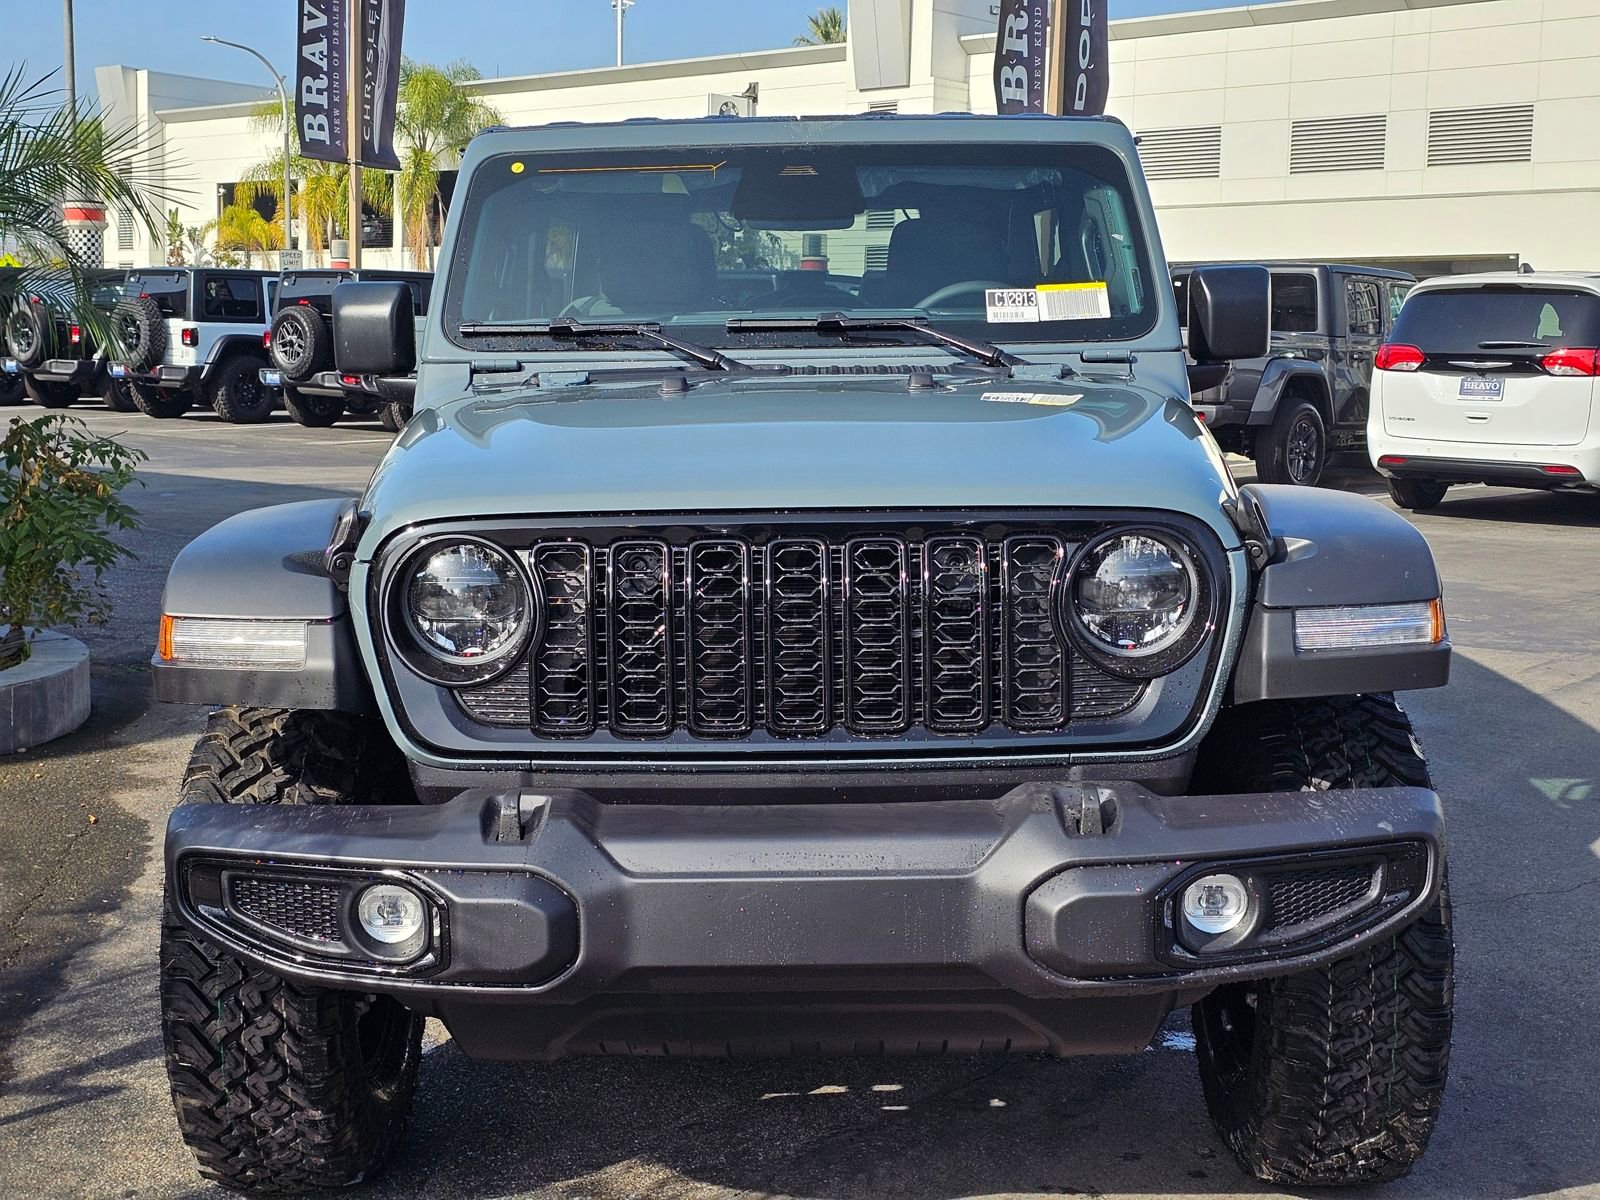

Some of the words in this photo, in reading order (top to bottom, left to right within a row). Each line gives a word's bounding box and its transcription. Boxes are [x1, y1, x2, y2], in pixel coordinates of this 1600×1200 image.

[1034, 7, 1042, 47] KIND
[333, 50, 340, 66] OF
[1001, 0, 1029, 107] BR
[1034, 99, 1041, 107] A
[994, 291, 1037, 307] C12813
[1463, 381, 1500, 390] BRAVO
